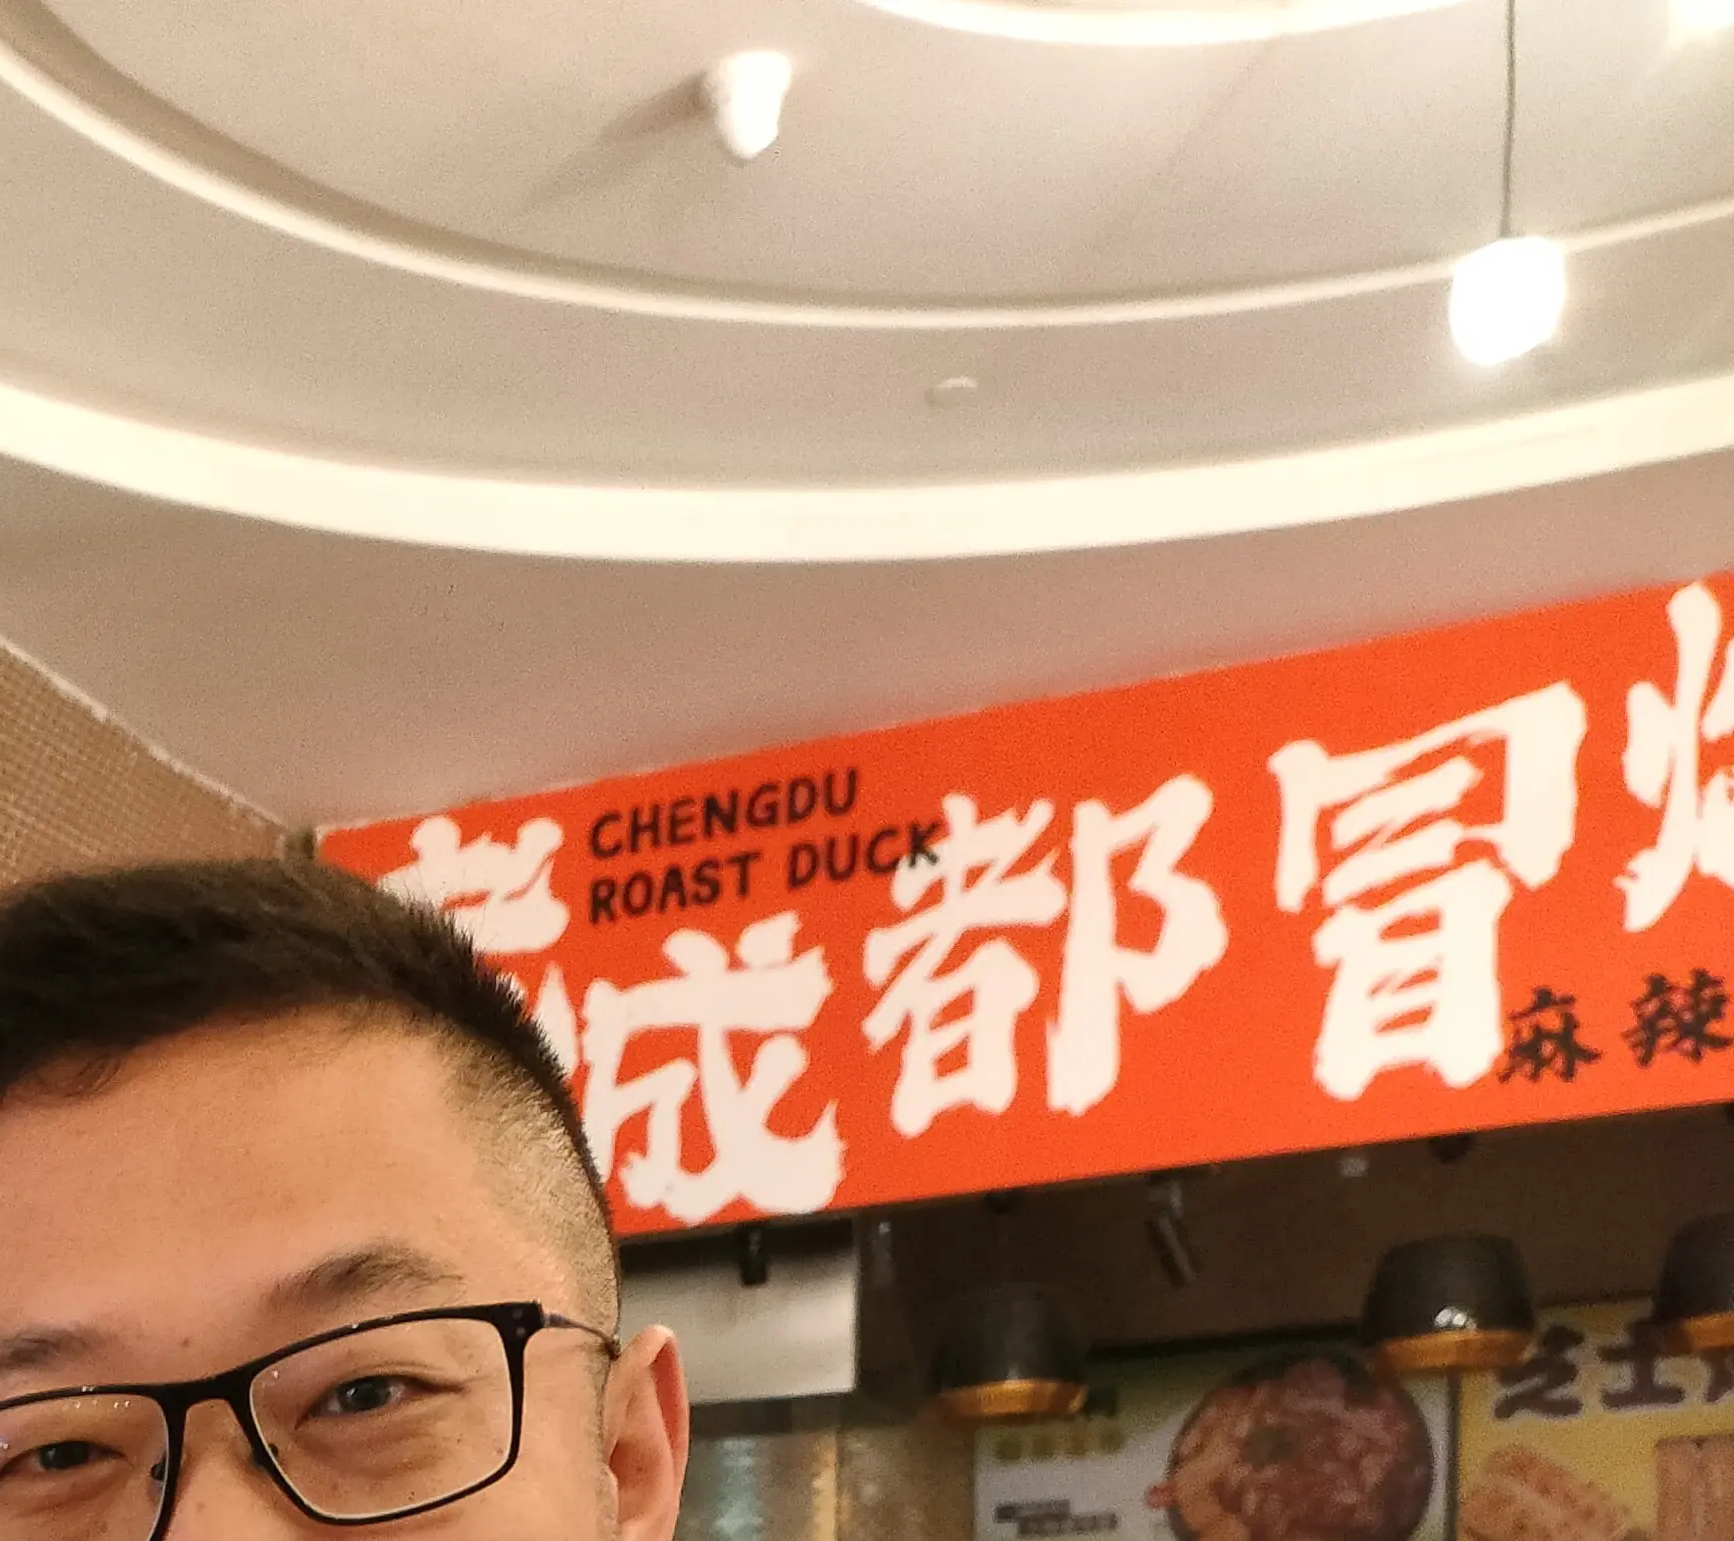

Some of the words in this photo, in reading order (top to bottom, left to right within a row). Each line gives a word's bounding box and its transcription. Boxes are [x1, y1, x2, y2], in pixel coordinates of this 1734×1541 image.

[588, 766, 859, 860] CHENGDU
[588, 850, 761, 926] ROAST
[786, 820, 943, 892] DUCK
[1498, 968, 1734, 1084] 麻辣
